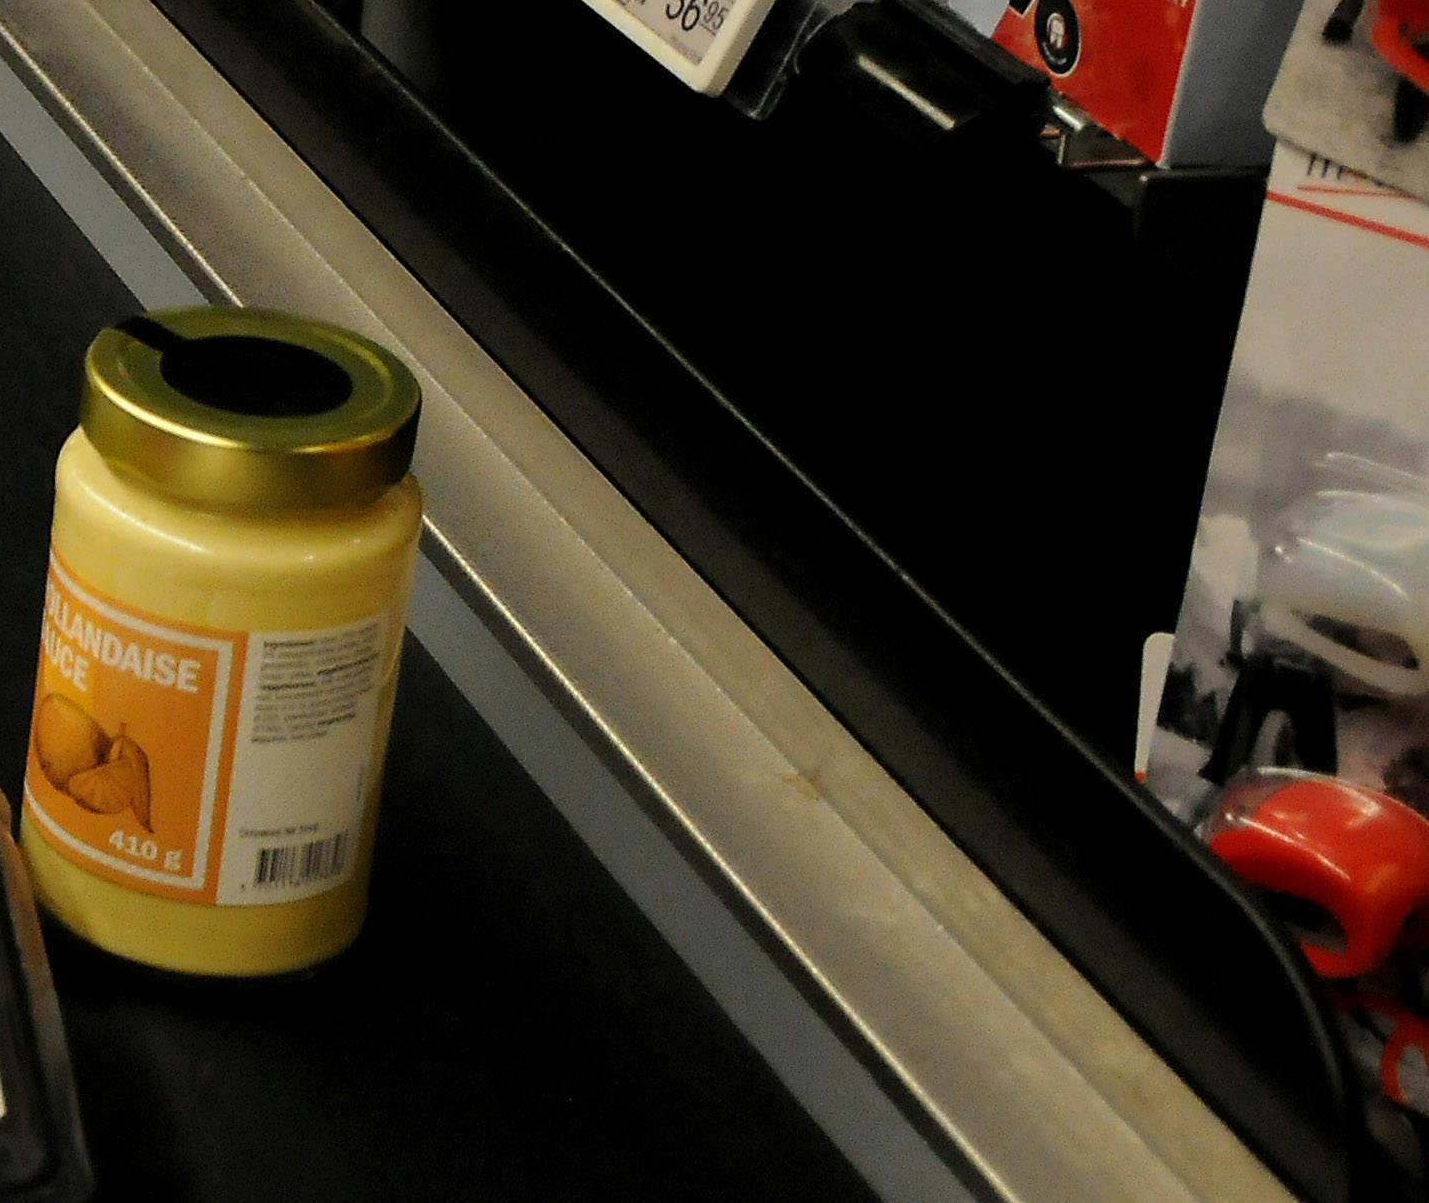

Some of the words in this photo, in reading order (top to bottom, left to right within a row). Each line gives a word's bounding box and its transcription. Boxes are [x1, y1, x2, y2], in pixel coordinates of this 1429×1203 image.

[703, 0, 730, 31] 95
[107, 827, 158, 861] 410
[165, 848, 183, 872] g
